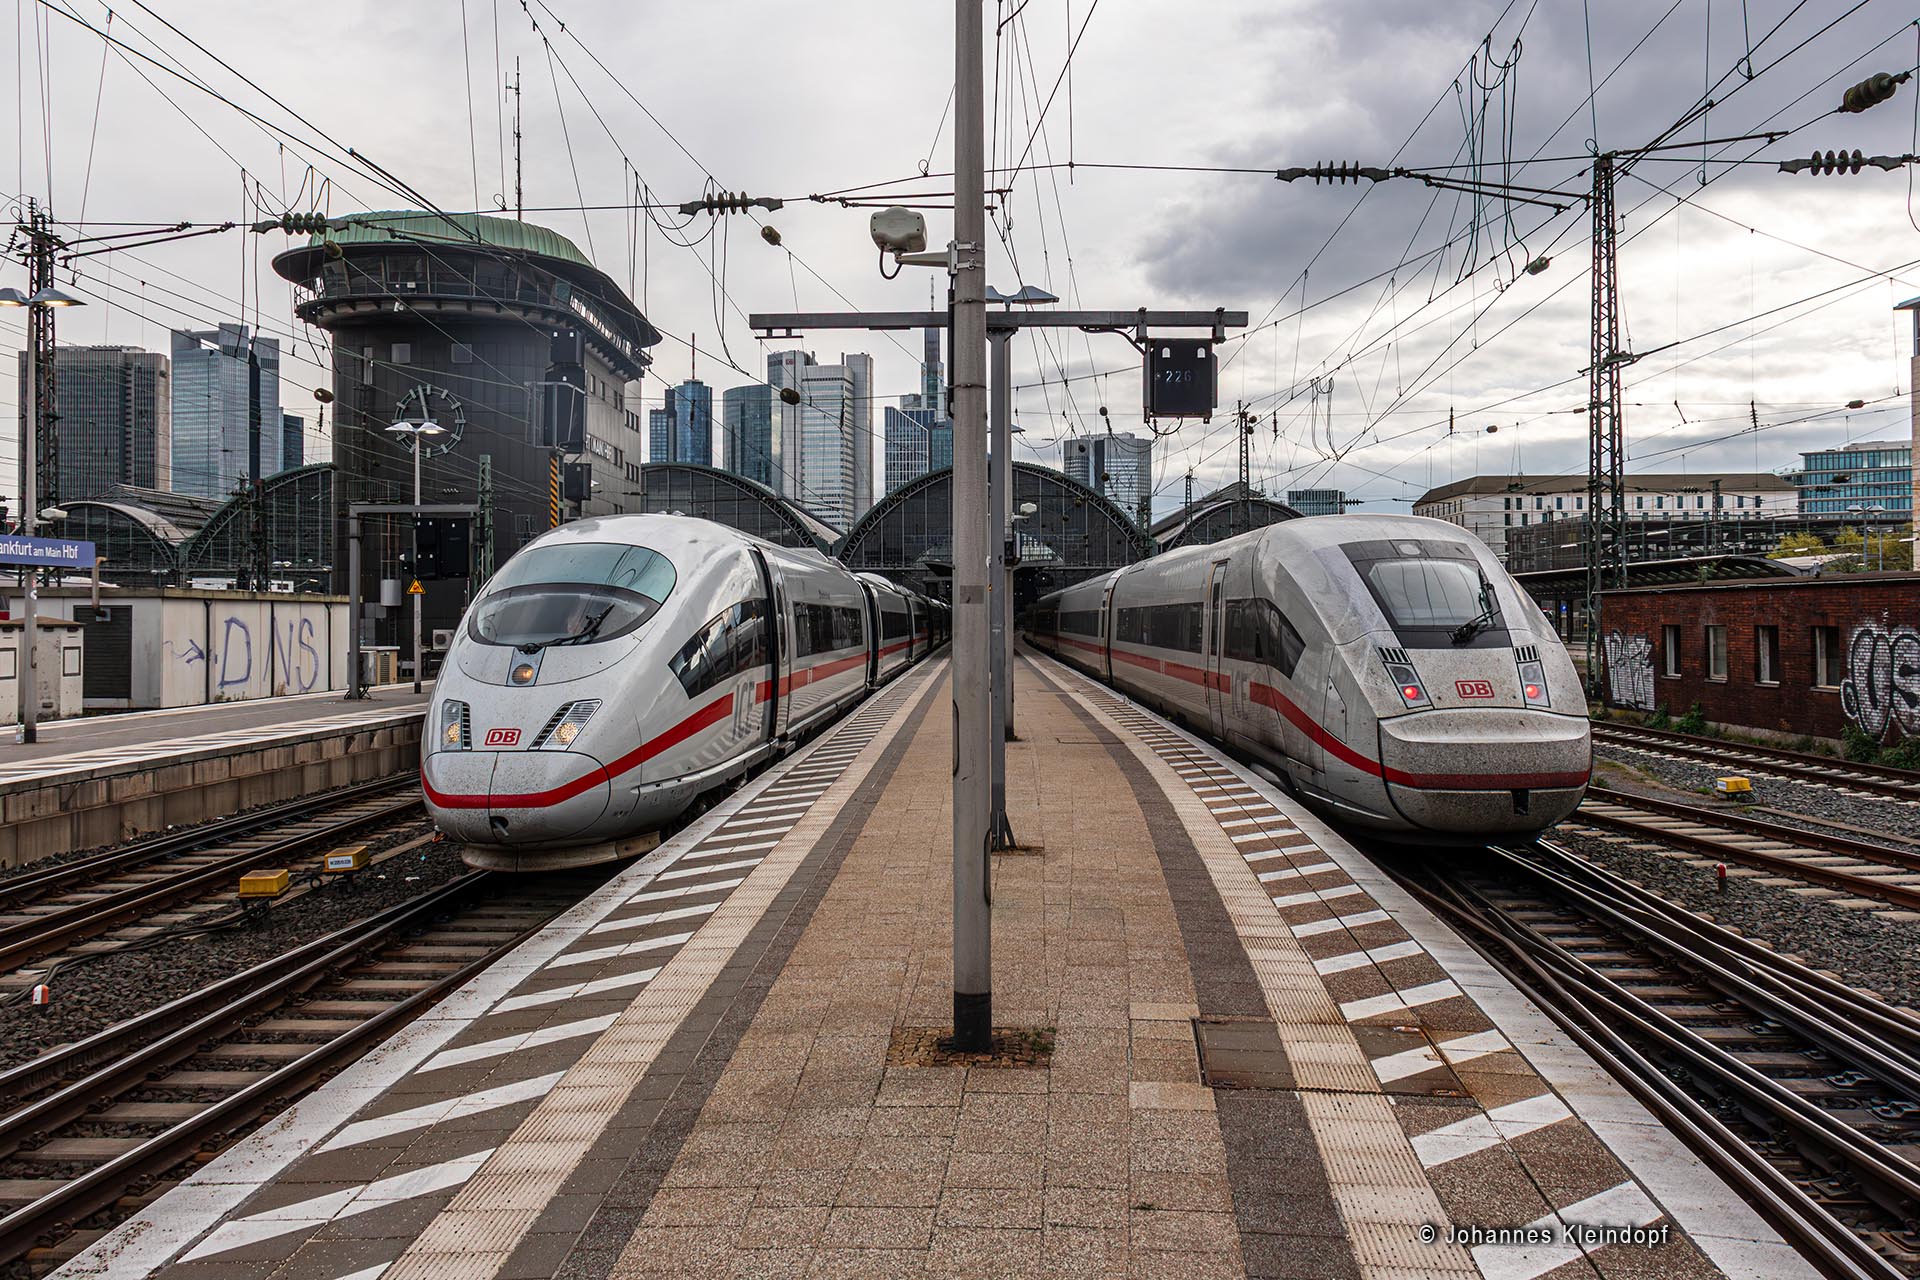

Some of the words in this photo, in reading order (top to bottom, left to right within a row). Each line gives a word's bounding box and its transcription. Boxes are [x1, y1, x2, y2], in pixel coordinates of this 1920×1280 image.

[33, 548, 44, 557] am
[45, 546, 62, 558] Main
[62, 544, 79, 559] Hbf
[218, 616, 319, 690] DNS
[1458, 682, 1491, 697] DB
[488, 730, 518, 744] DB
